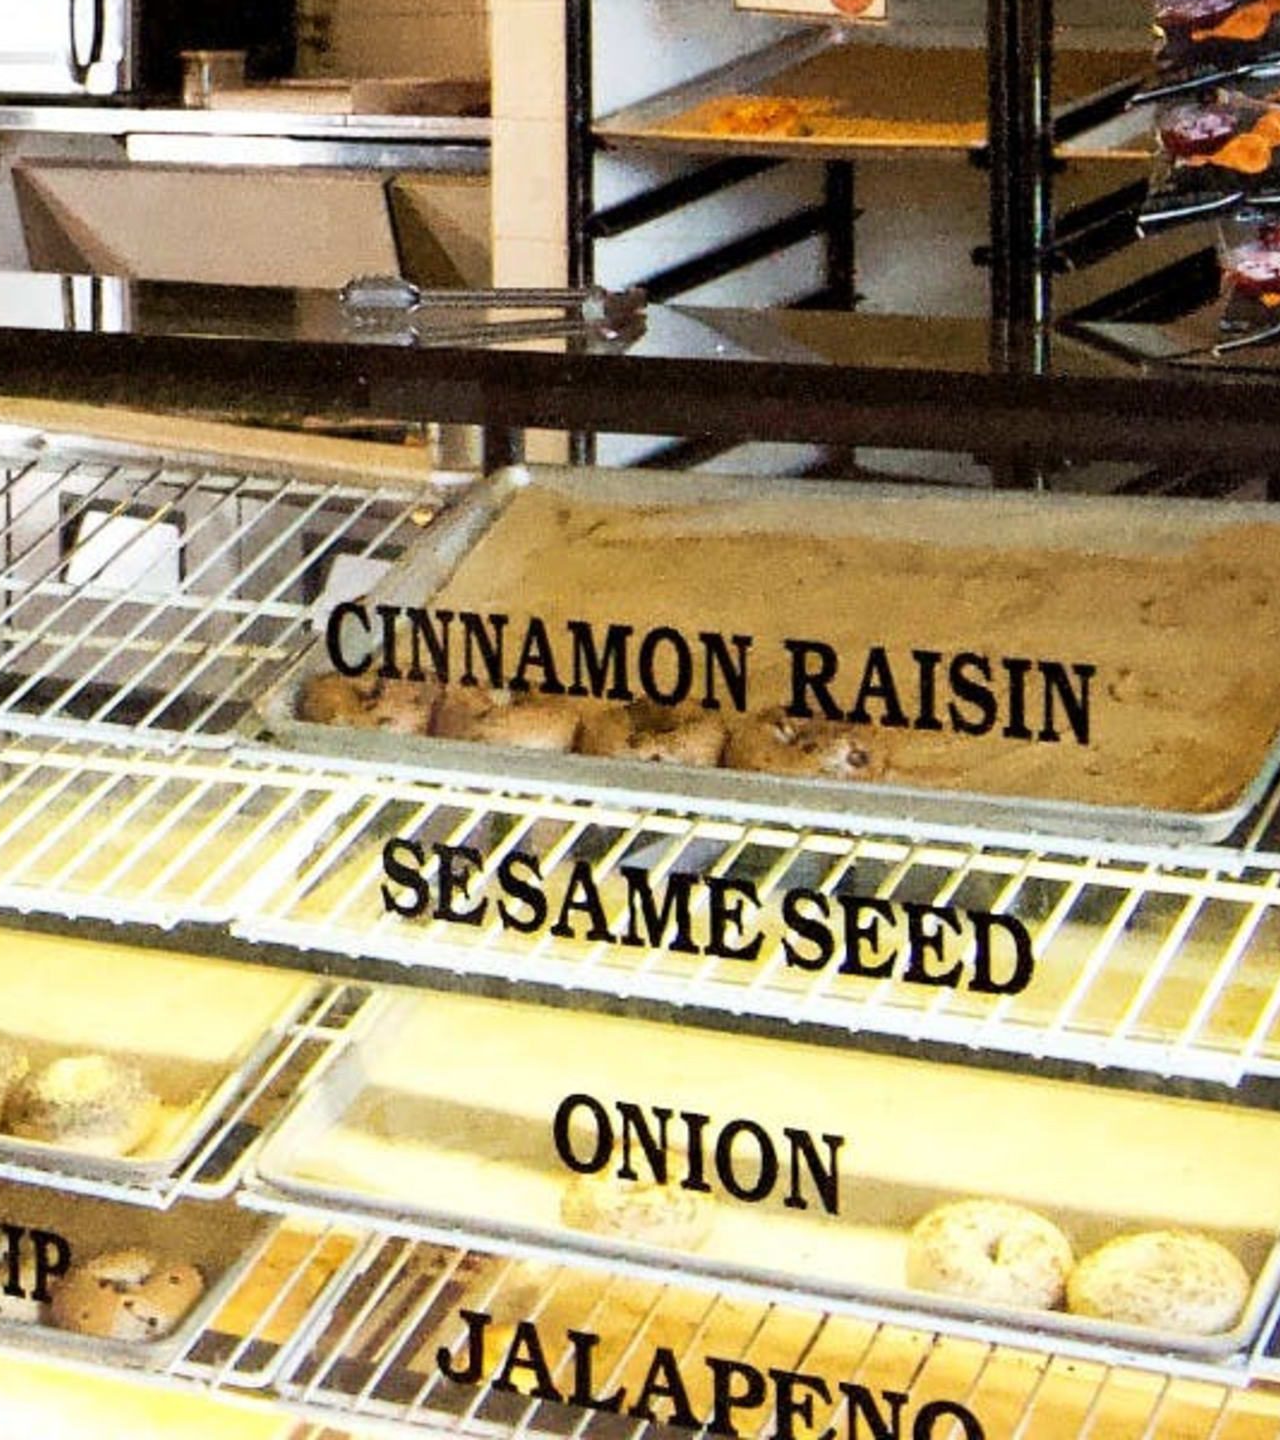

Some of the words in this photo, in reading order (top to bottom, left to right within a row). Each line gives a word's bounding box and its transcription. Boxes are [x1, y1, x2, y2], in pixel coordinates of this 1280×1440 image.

[326, 600, 753, 712] CINNAMON
[785, 638, 1096, 746] RAISIN
[381, 837, 765, 962] SESAME
[781, 890, 1035, 997] SEED
[554, 1092, 845, 1217] ONION
